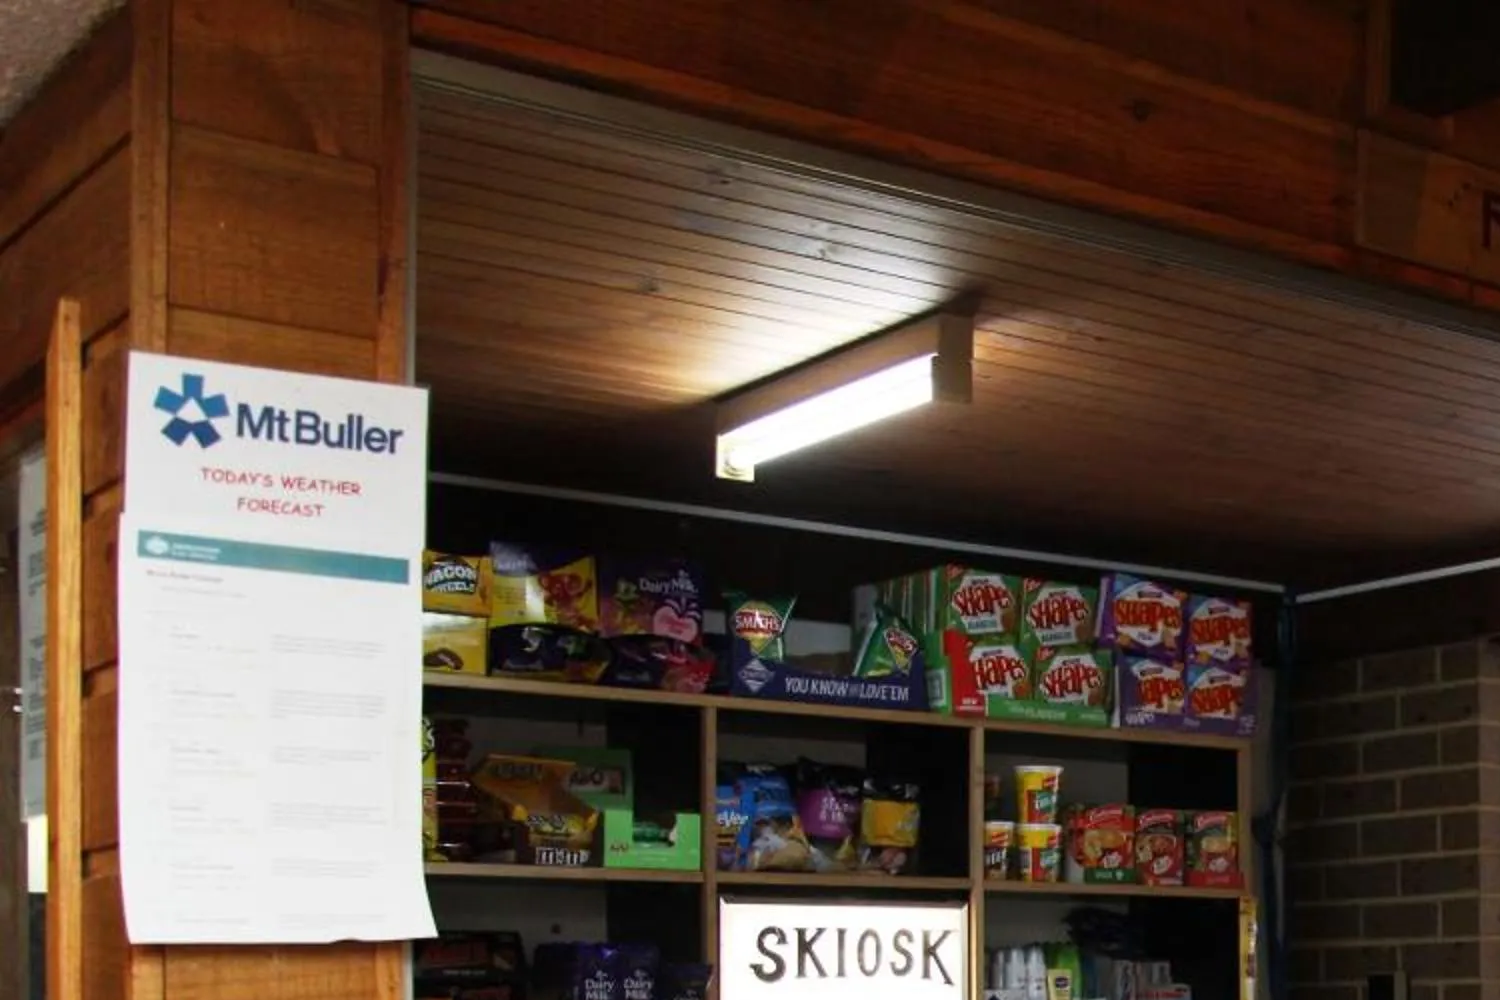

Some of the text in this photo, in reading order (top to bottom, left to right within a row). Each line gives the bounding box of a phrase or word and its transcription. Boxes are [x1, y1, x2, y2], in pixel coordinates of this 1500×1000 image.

[201, 467, 363, 496] TODAY'S WEATHER
[236, 497, 326, 517] FORECAST
[785, 677, 810, 694] YOU
[810, 678, 851, 696] KNOW
[749, 926, 955, 986] SKIOSK
[585, 978, 616, 994] Dairy
